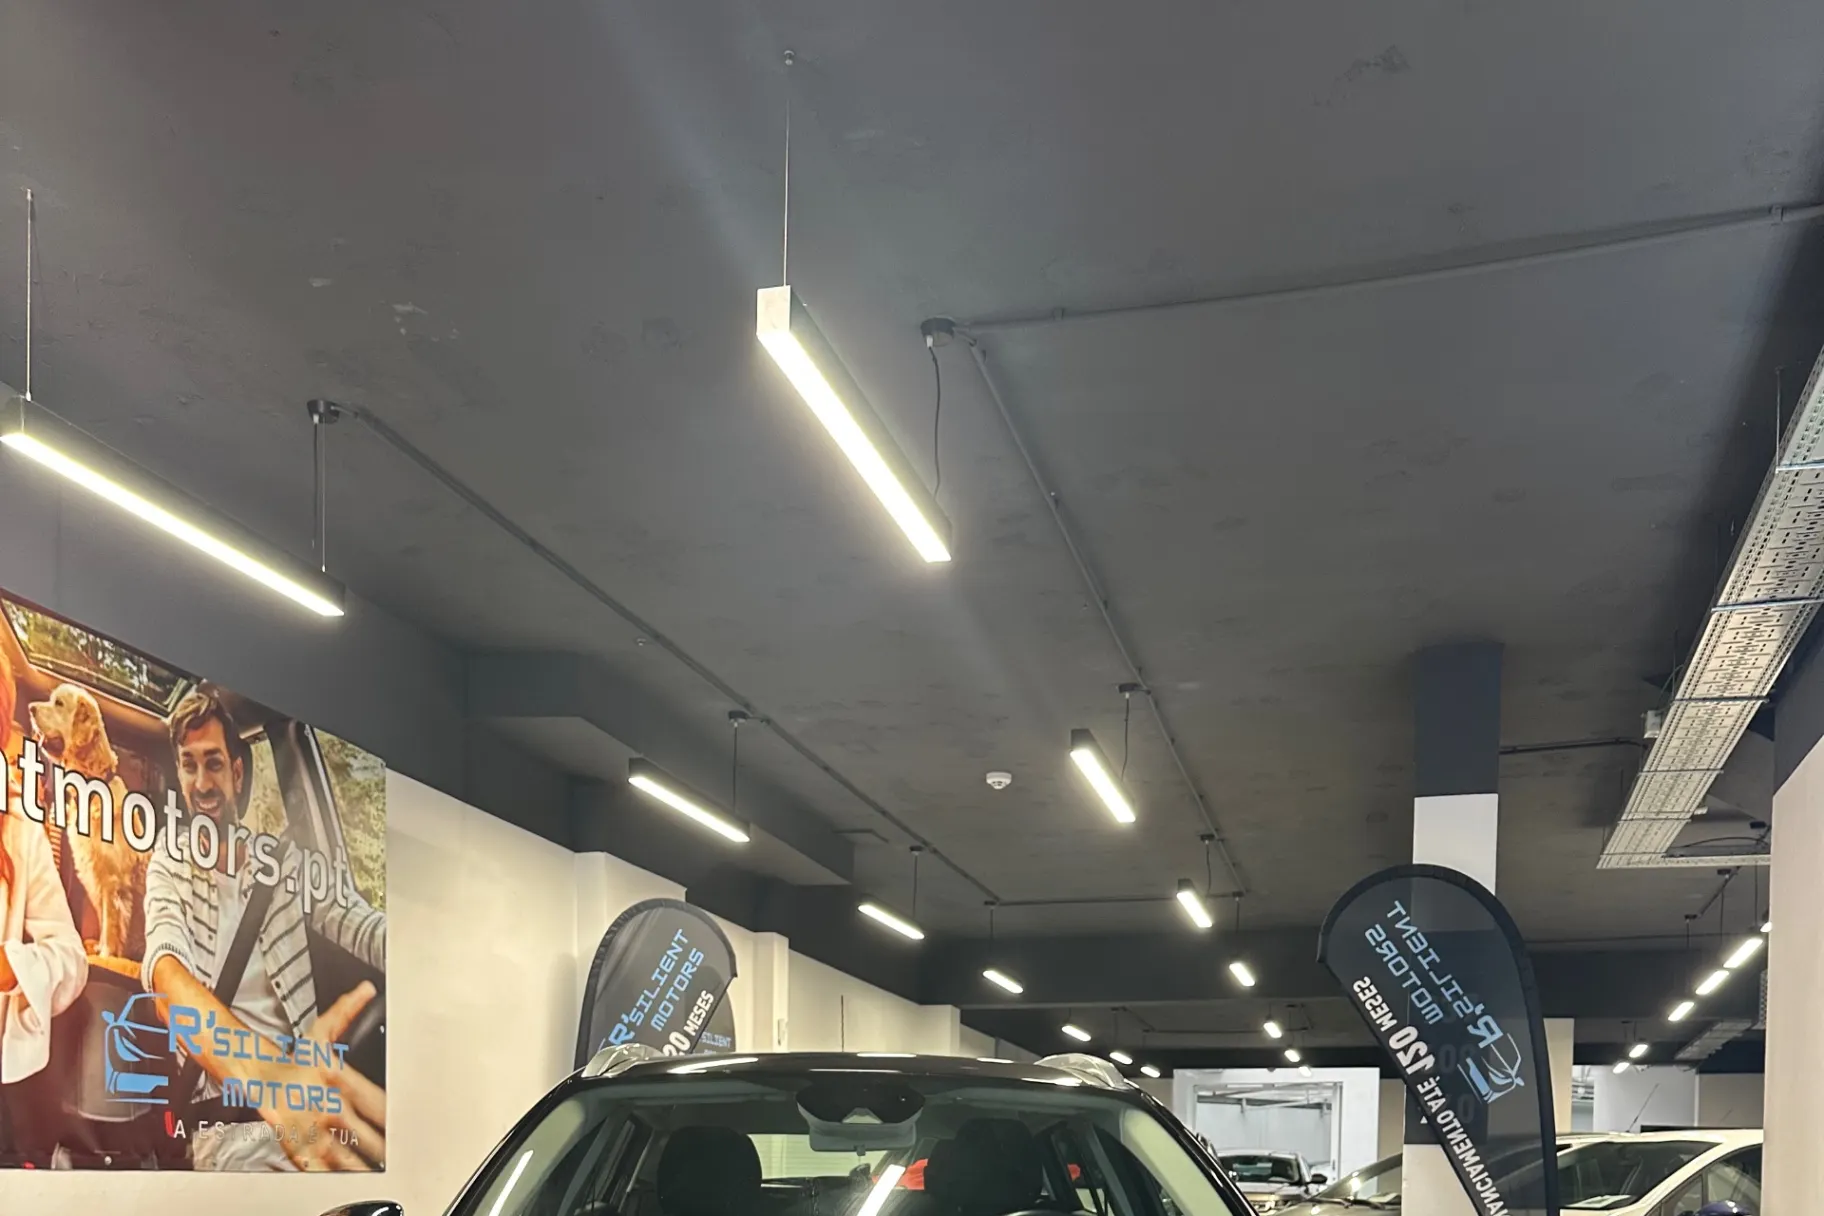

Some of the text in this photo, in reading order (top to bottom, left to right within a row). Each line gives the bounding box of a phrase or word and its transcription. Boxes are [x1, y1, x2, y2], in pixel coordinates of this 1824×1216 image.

[650, 947, 705, 1032] MOTORS
[683, 989, 714, 1037] MESES
[168, 1004, 350, 1071] R'SILIENT
[222, 1077, 344, 1114] MOTORS
[173, 1119, 187, 1139] A
[198, 1120, 301, 1144] ESTRADA
[329, 1126, 359, 1147] TUA
